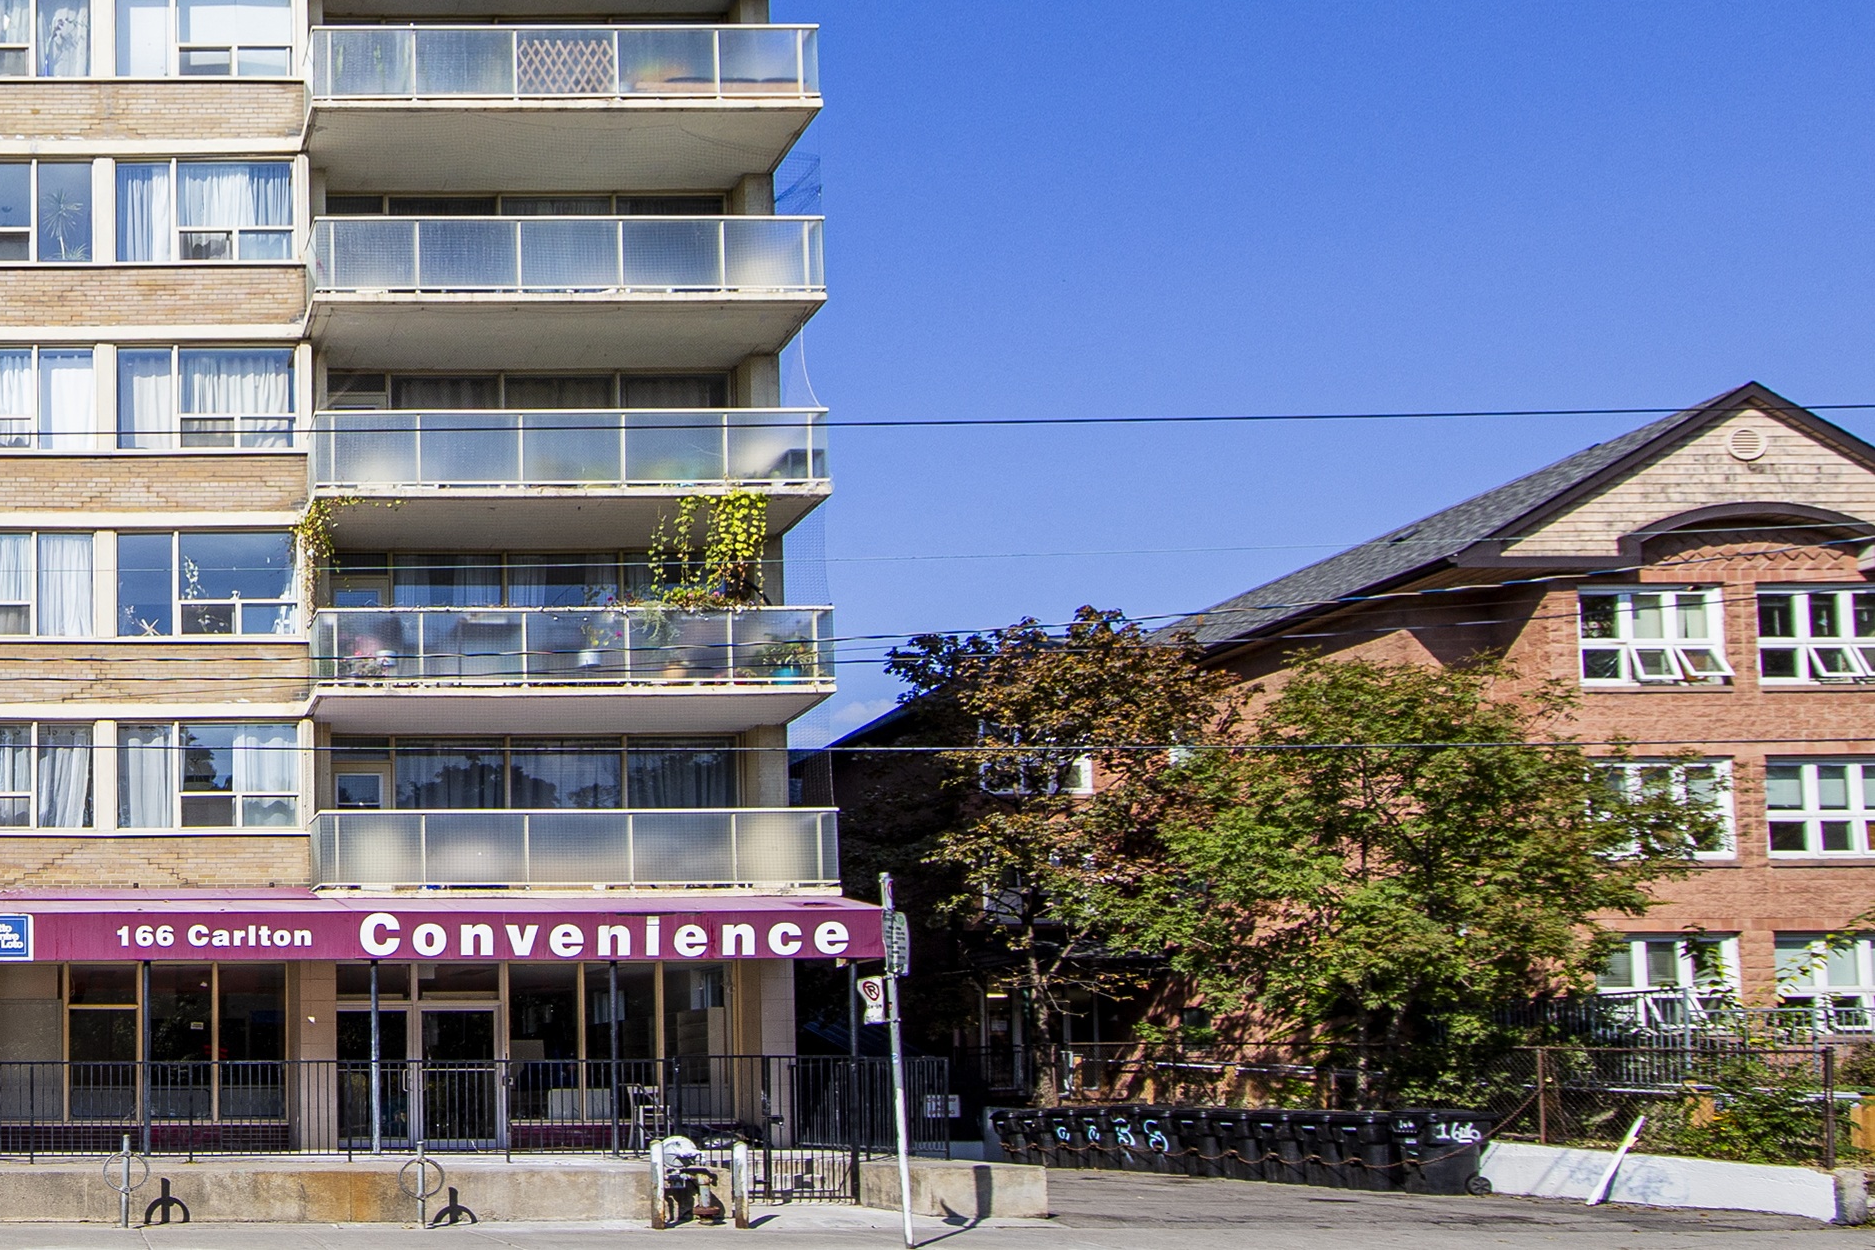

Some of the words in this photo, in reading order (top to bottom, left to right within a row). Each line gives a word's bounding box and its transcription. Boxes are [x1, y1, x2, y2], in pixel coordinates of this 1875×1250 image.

[1, 940, 24, 949] Loto
[116, 924, 175, 947] 166
[187, 924, 312, 947] Carlton
[359, 912, 850, 957] Convenience
